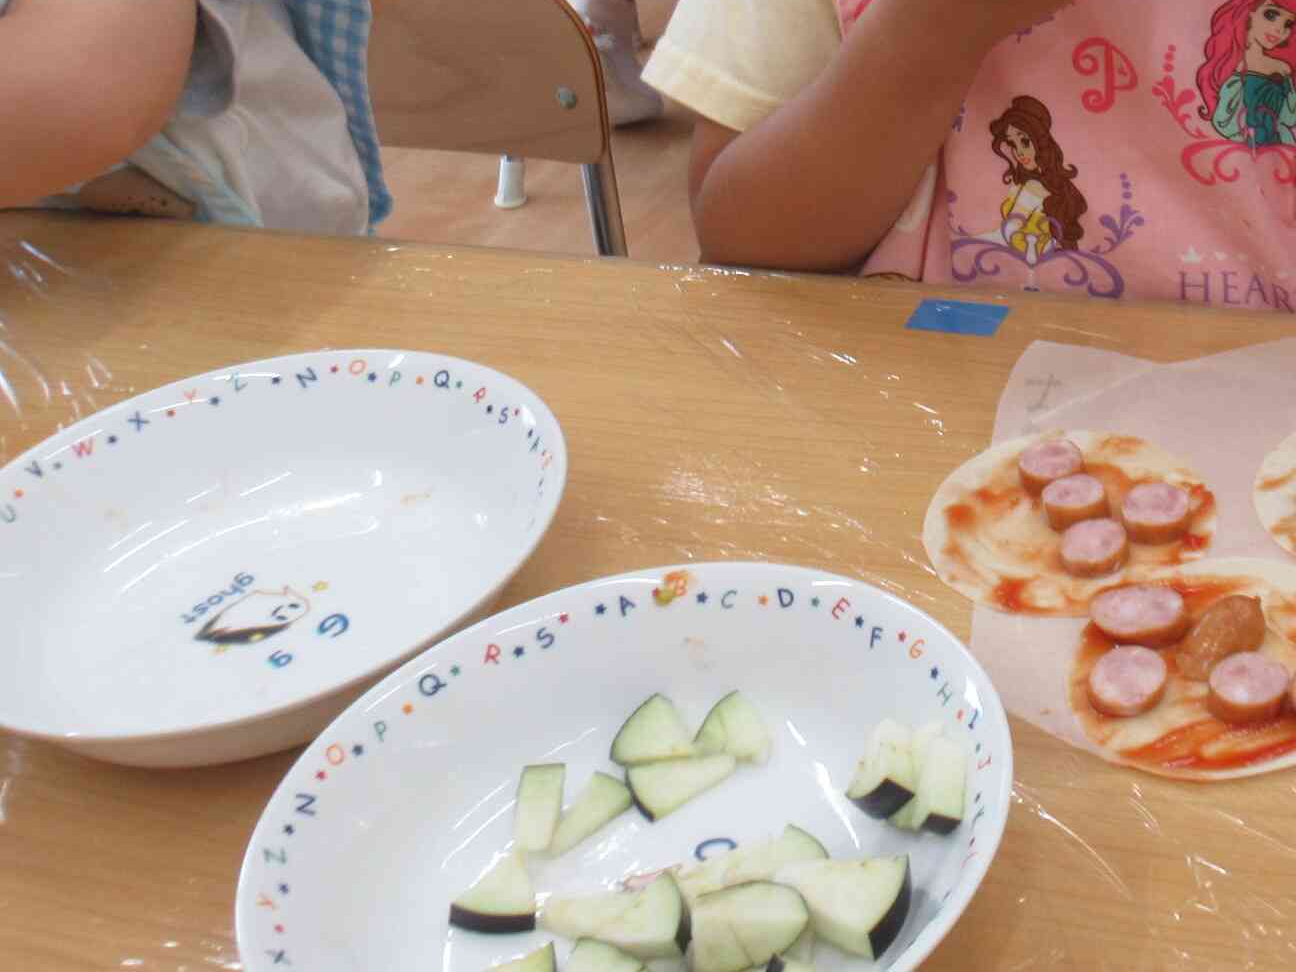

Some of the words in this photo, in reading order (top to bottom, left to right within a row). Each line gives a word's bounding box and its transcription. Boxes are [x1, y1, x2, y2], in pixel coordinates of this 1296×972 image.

[71, 436, 96, 459] W
[127, 411, 150, 432] X
[295, 366, 318, 389] N
[388, 370, 402, 387] P
[433, 369, 450, 389] Q
[472, 386, 487, 403] R
[498, 406, 509, 424] S
[180, 572, 255, 625] ghost
[295, 792, 317, 817] N
[373, 720, 387, 742] P
[418, 673, 447, 697] Q
[483, 643, 501, 666] R
[535, 627, 555, 649] S
[618, 595, 636, 617] A
[719, 589, 738, 610] C
[776, 587, 795, 609] D
[830, 596, 850, 621] E
[869, 626, 883, 650] F
[907, 638, 925, 660] G
[936, 681, 952, 706] H
